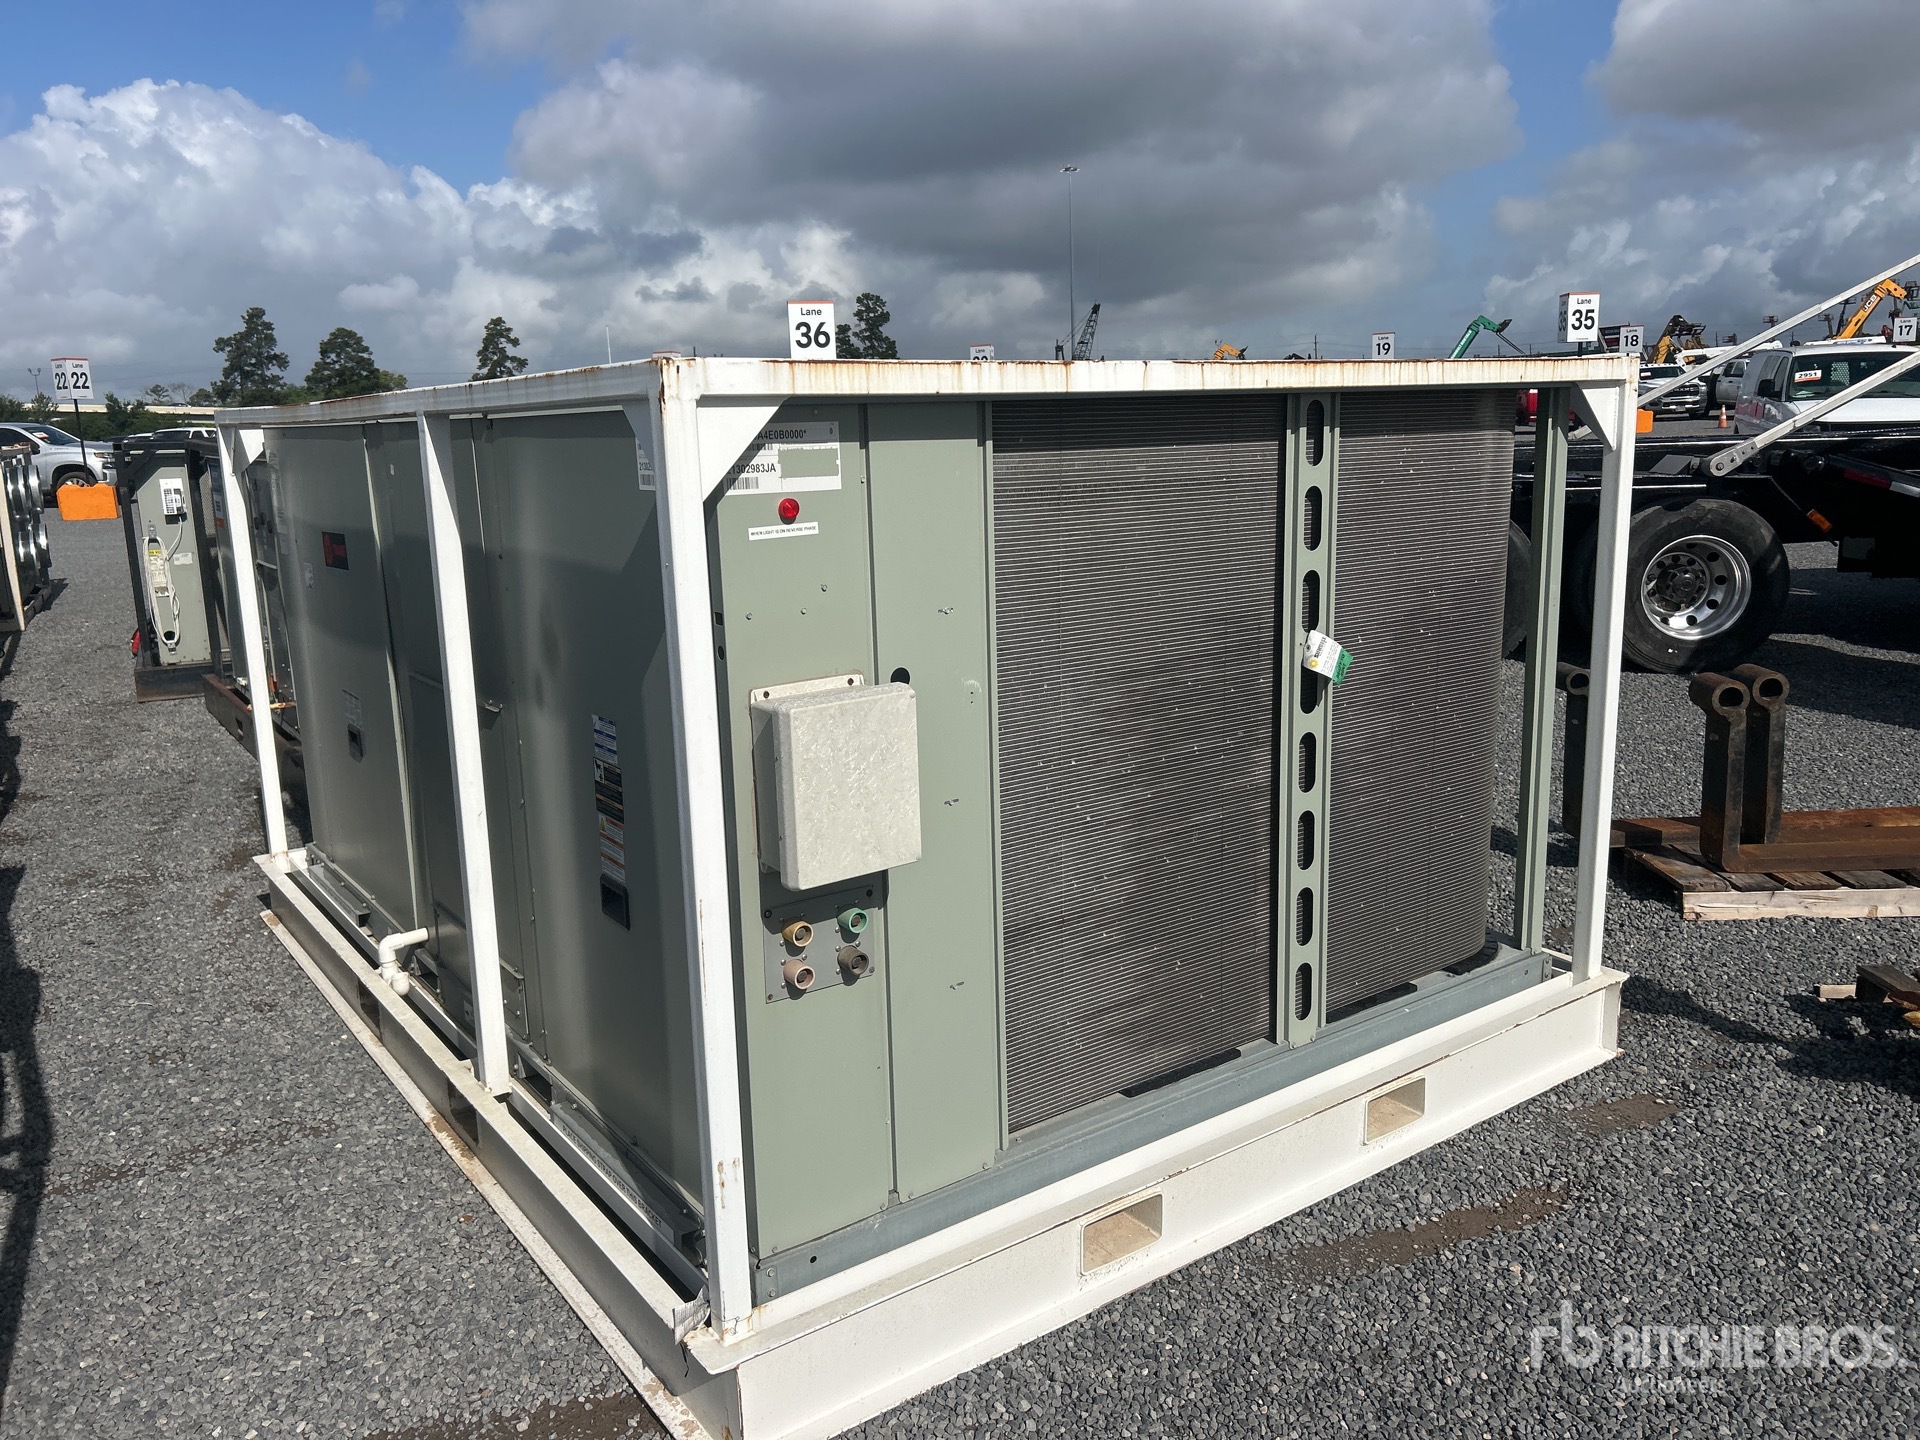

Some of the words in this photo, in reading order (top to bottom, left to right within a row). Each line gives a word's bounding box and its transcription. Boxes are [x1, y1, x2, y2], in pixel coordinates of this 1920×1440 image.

[800, 307, 822, 316] Lane
[1571, 309, 1595, 331] 35
[795, 321, 831, 349] 36
[1898, 325, 1913, 336] 17
[1623, 334, 1639, 347] 18
[1375, 342, 1391, 355] 19
[55, 372, 68, 390] 22
[71, 372, 90, 390] 22
[754, 429, 807, 440] A4E0B0000
